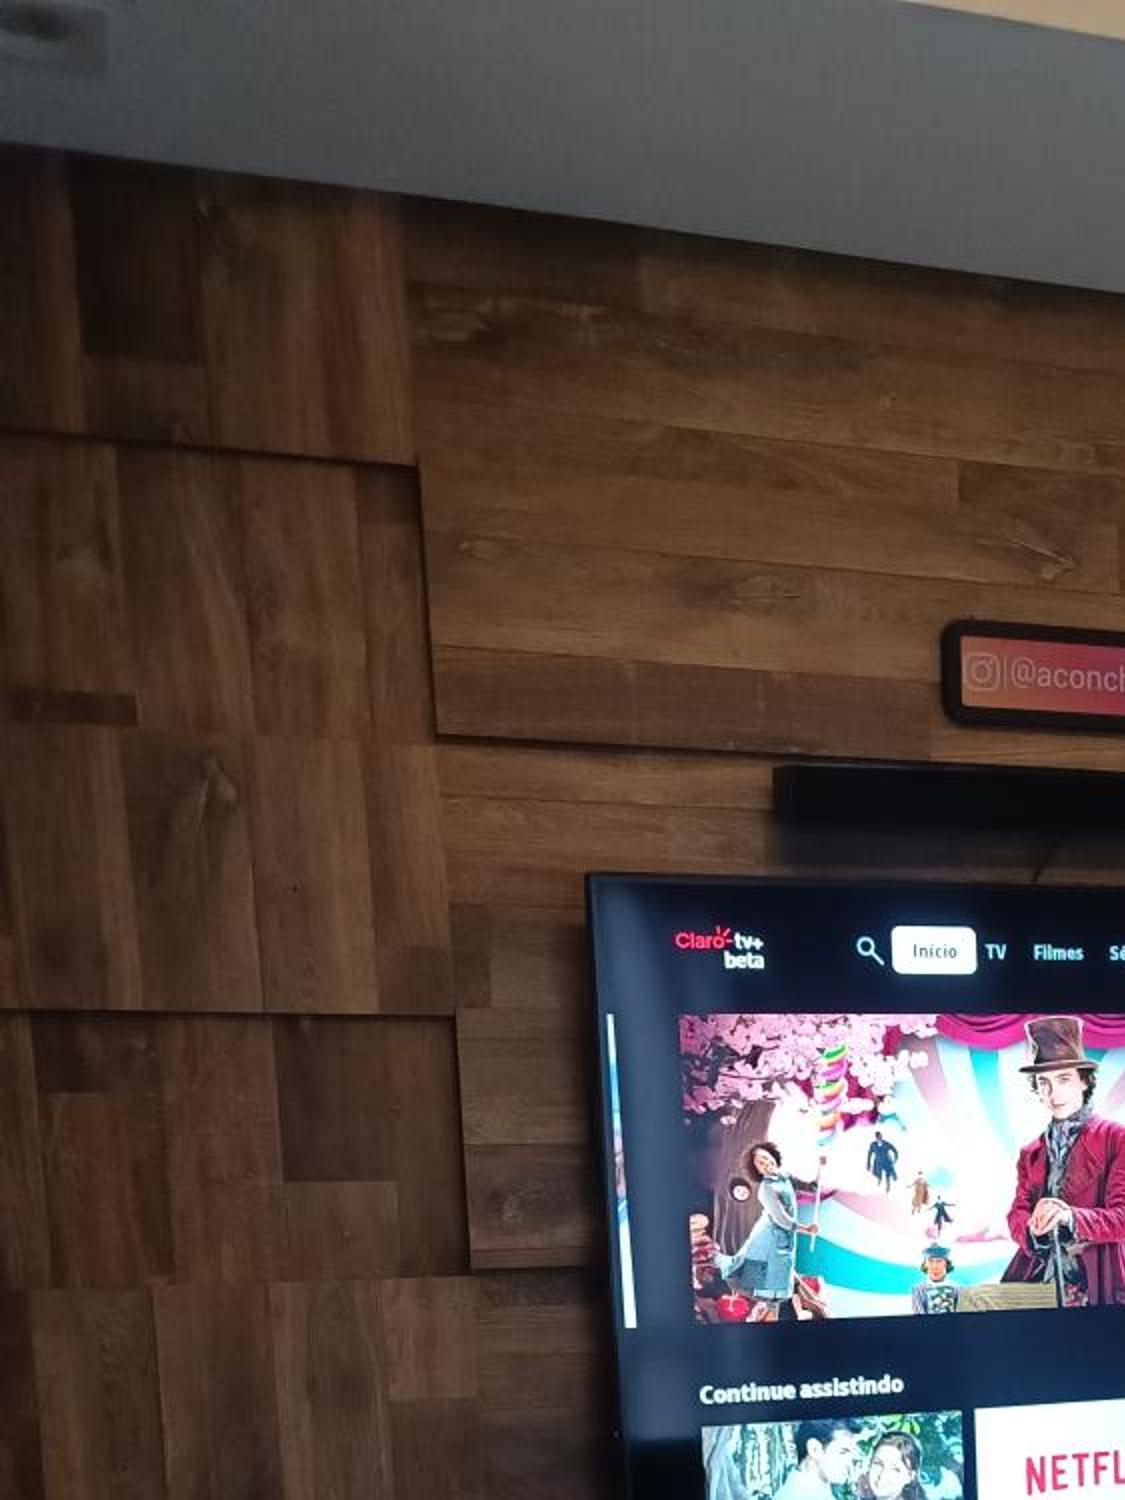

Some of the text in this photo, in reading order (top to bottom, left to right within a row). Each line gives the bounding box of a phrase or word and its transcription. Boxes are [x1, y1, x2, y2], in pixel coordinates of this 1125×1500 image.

[674, 927, 731, 951] Claro
[723, 951, 765, 969] beta
[984, 943, 1008, 961] TV
[1033, 943, 1085, 962] Filmes
[699, 1374, 905, 1405] Continue assistindo
